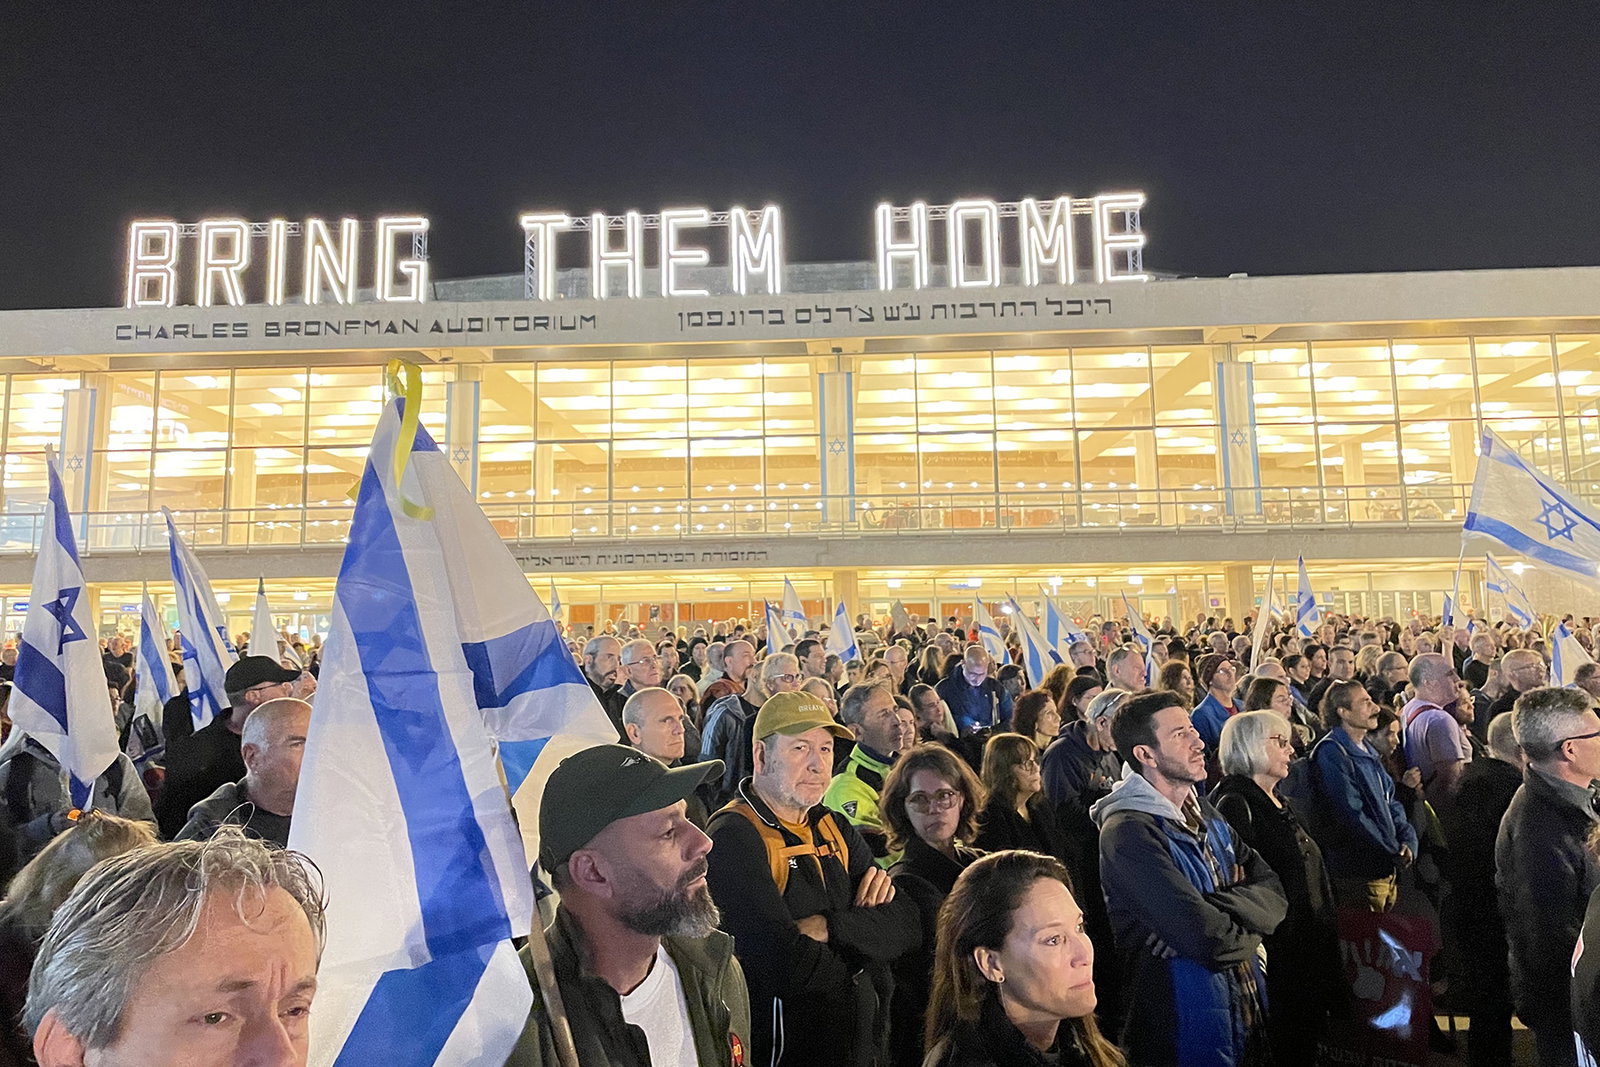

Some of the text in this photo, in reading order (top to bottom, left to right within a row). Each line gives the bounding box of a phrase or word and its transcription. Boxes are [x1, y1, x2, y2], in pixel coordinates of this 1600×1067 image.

[126, 193, 1149, 309] BRING THEM HOME
[930, 301, 1038, 320] התרבות
[1045, 297, 1112, 316] היכל
[115, 314, 597, 341] CHARLES BRONFMAN AUDITORIUM
[678, 309, 786, 332] ברונפמן
